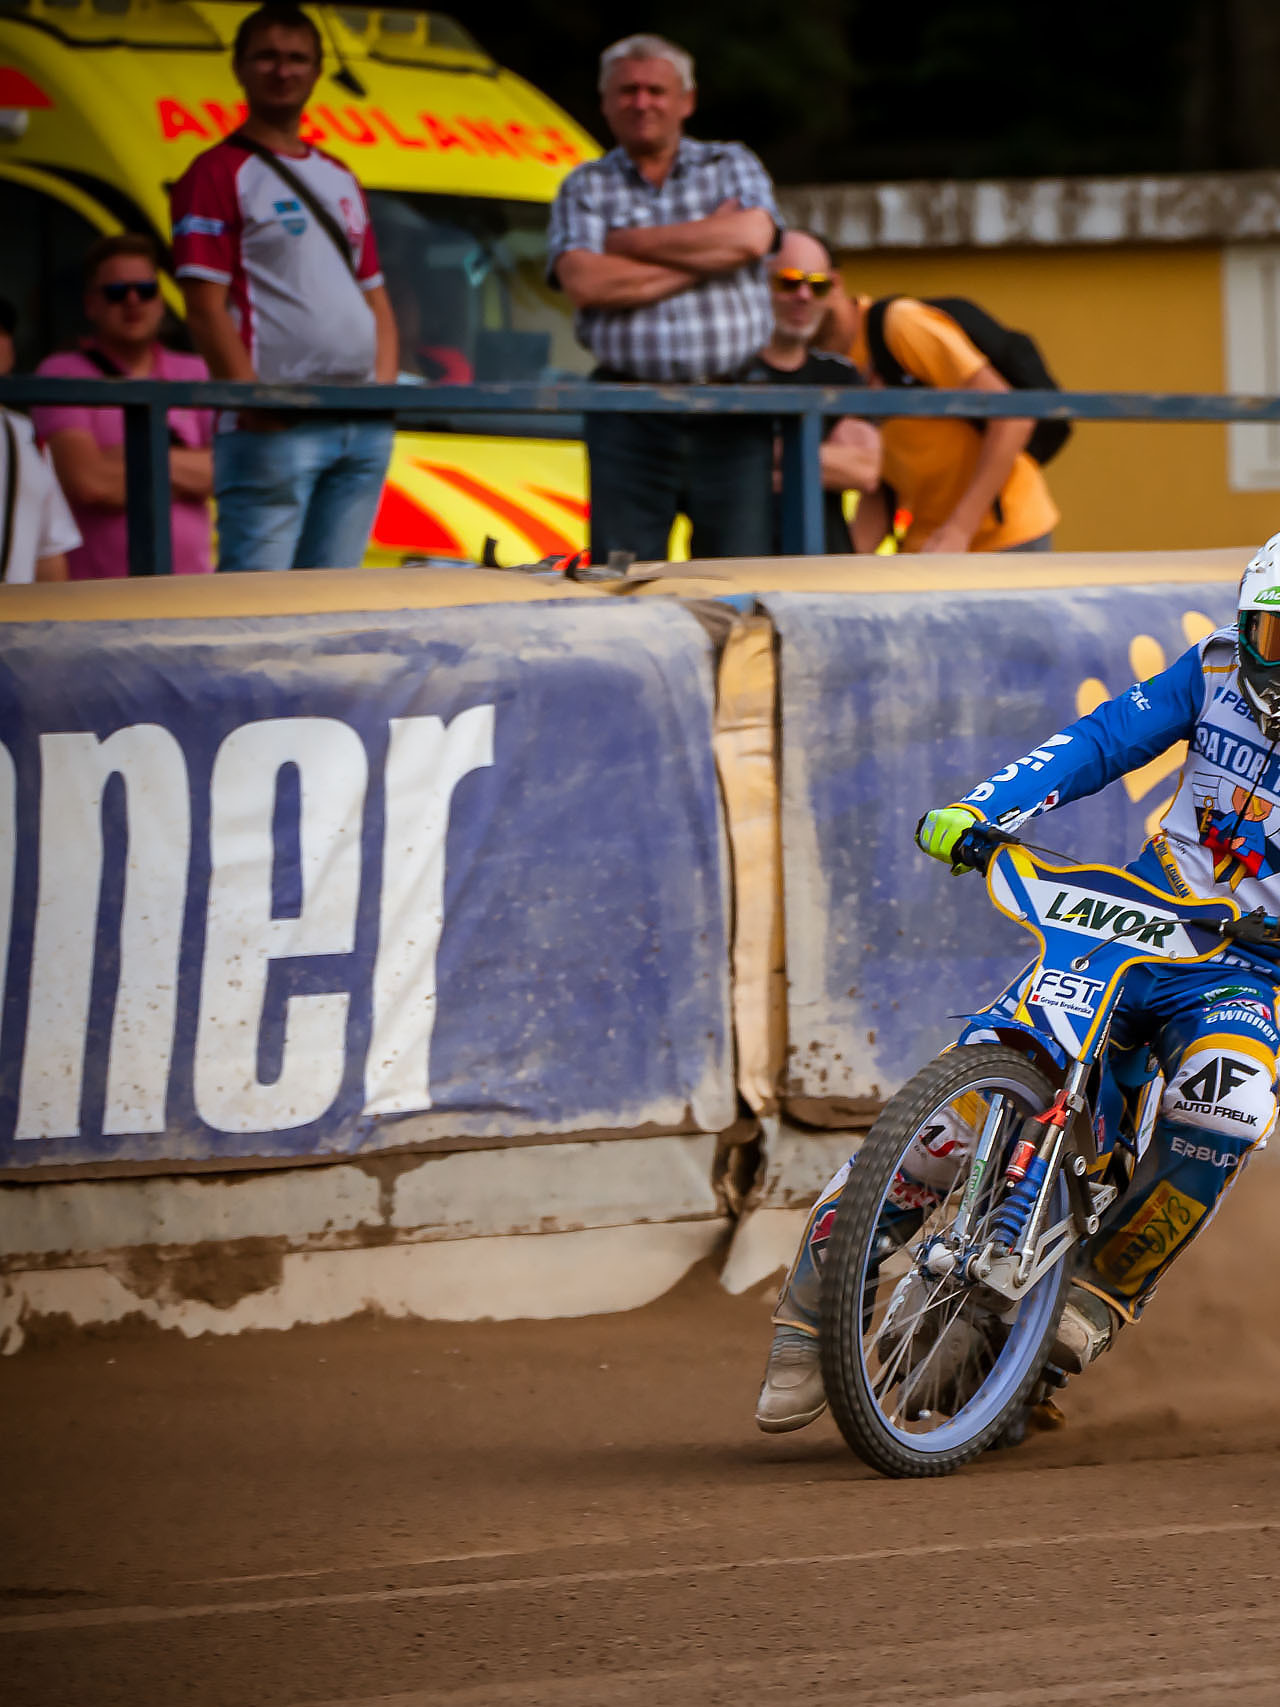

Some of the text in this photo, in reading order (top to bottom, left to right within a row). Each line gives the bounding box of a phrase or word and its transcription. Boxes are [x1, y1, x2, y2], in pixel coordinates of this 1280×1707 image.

[1192, 726, 1271, 787] PATOR
[0, 703, 496, 1141] ner
[1045, 890, 1176, 949] LAVOR
[1036, 971, 1102, 1004] FST
[1173, 1100, 1258, 1127] AUTO FRELIK
[1170, 1136, 1239, 1168] ERBUD
